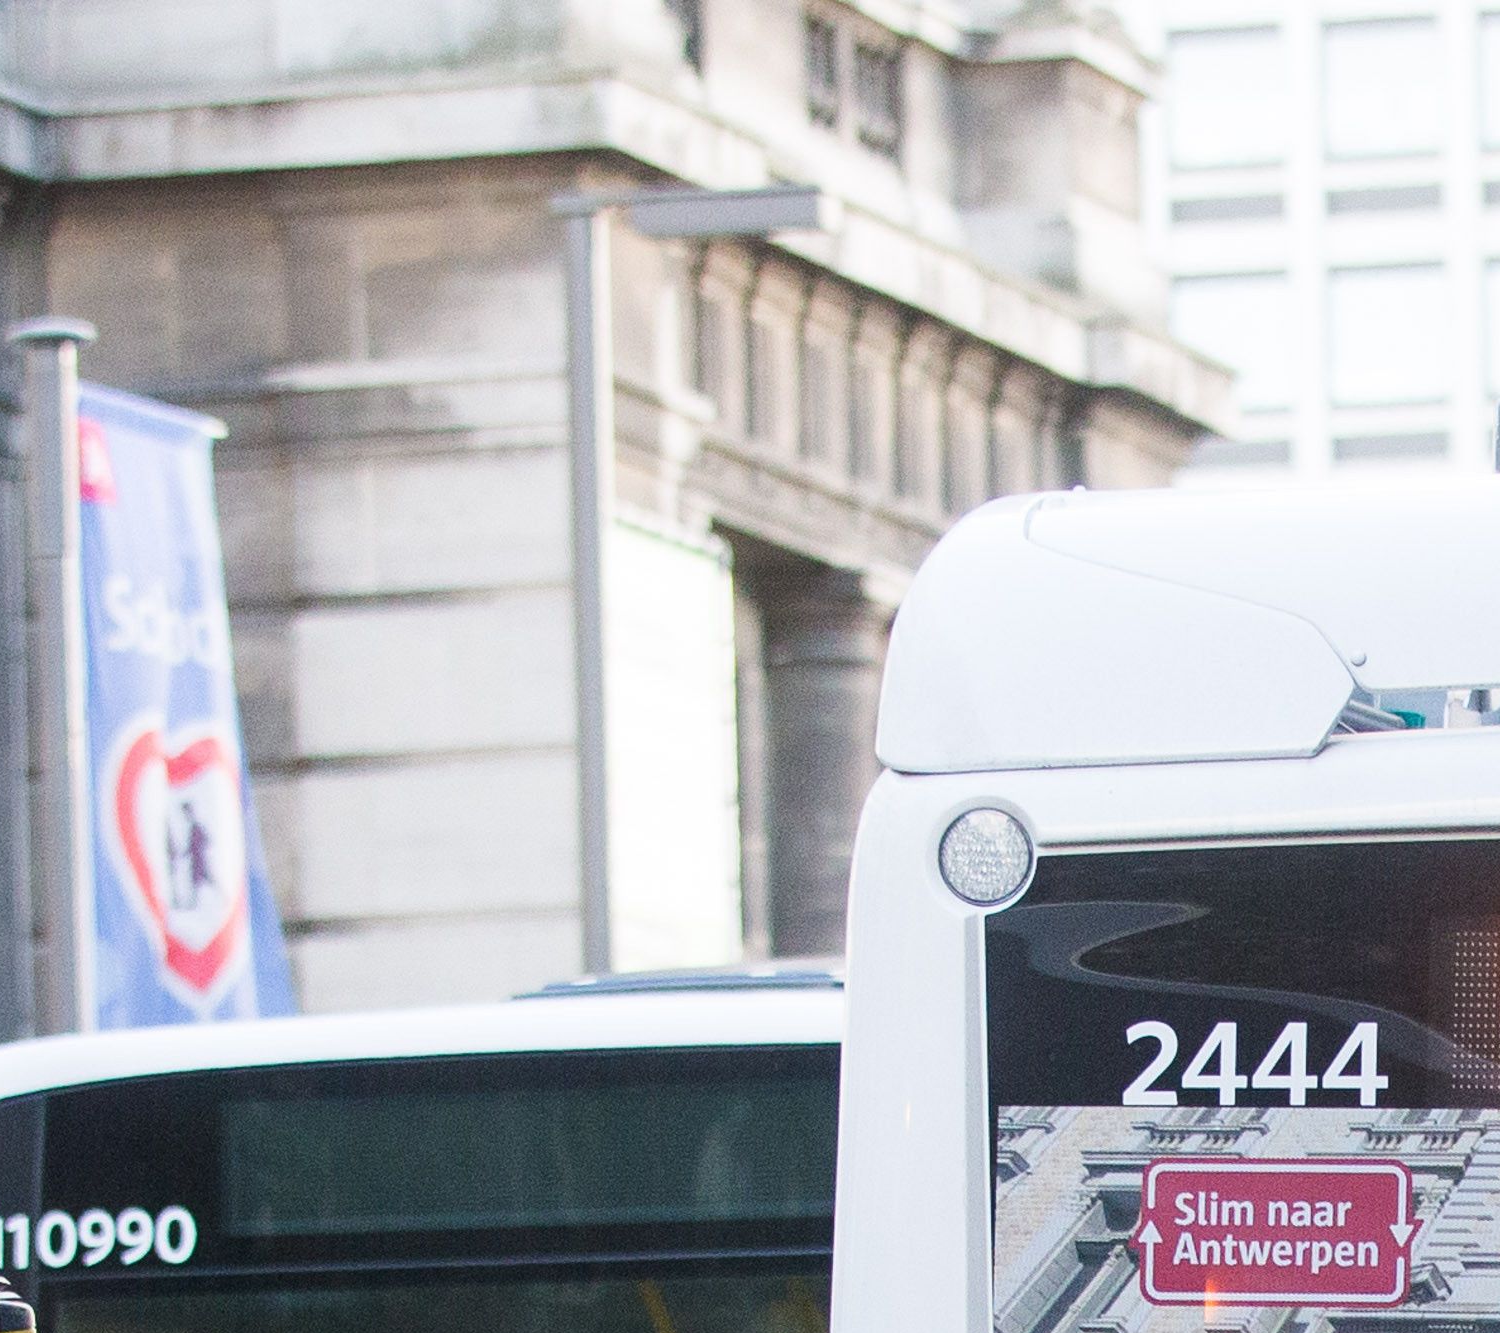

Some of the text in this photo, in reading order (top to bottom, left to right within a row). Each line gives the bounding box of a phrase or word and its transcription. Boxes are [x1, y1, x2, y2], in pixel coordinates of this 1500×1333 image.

[1122, 1020, 1389, 1107] 2444
[1174, 1191, 1351, 1229] Slim naar
[1173, 1233, 1380, 1274] Antwerpen
